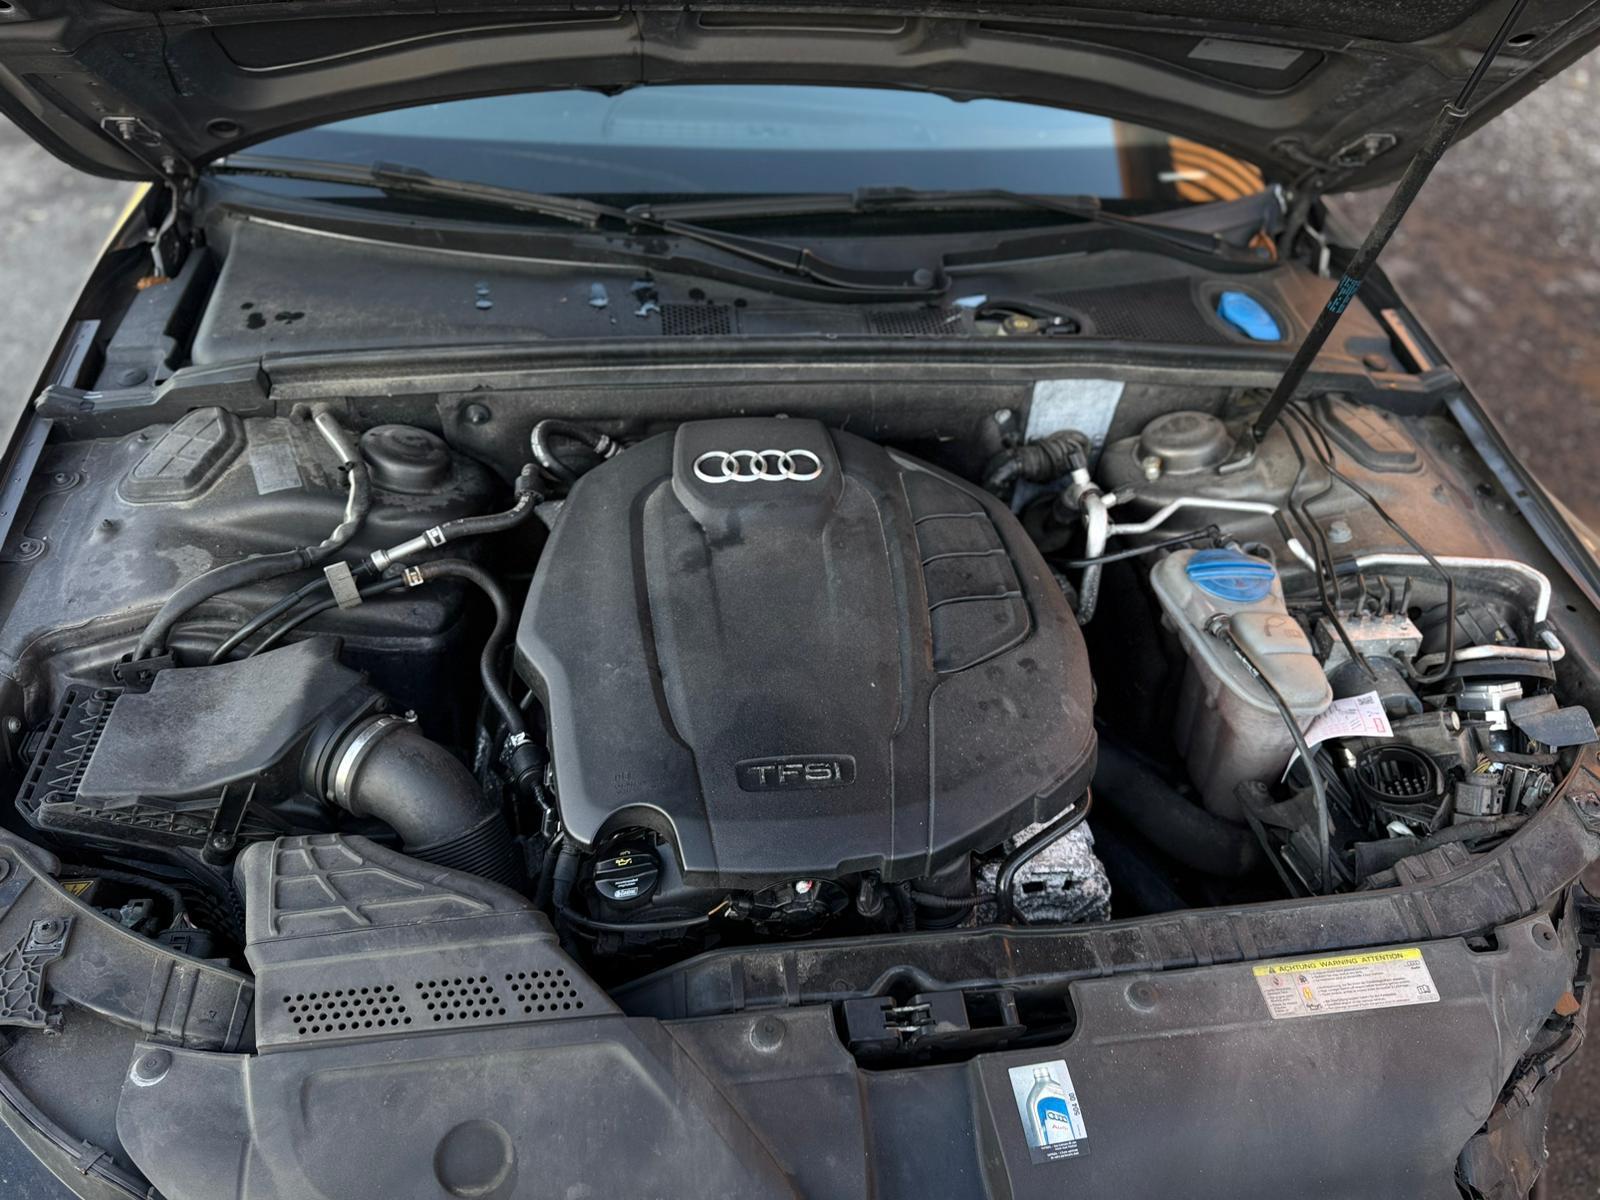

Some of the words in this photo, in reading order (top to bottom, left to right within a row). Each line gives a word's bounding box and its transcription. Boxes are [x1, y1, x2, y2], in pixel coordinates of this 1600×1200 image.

[751, 762, 841, 784] TFSI
[1279, 963, 1316, 973] ACHTUNG
[1320, 958, 1358, 968] WARNING
[1361, 953, 1404, 963] ATTENTION
